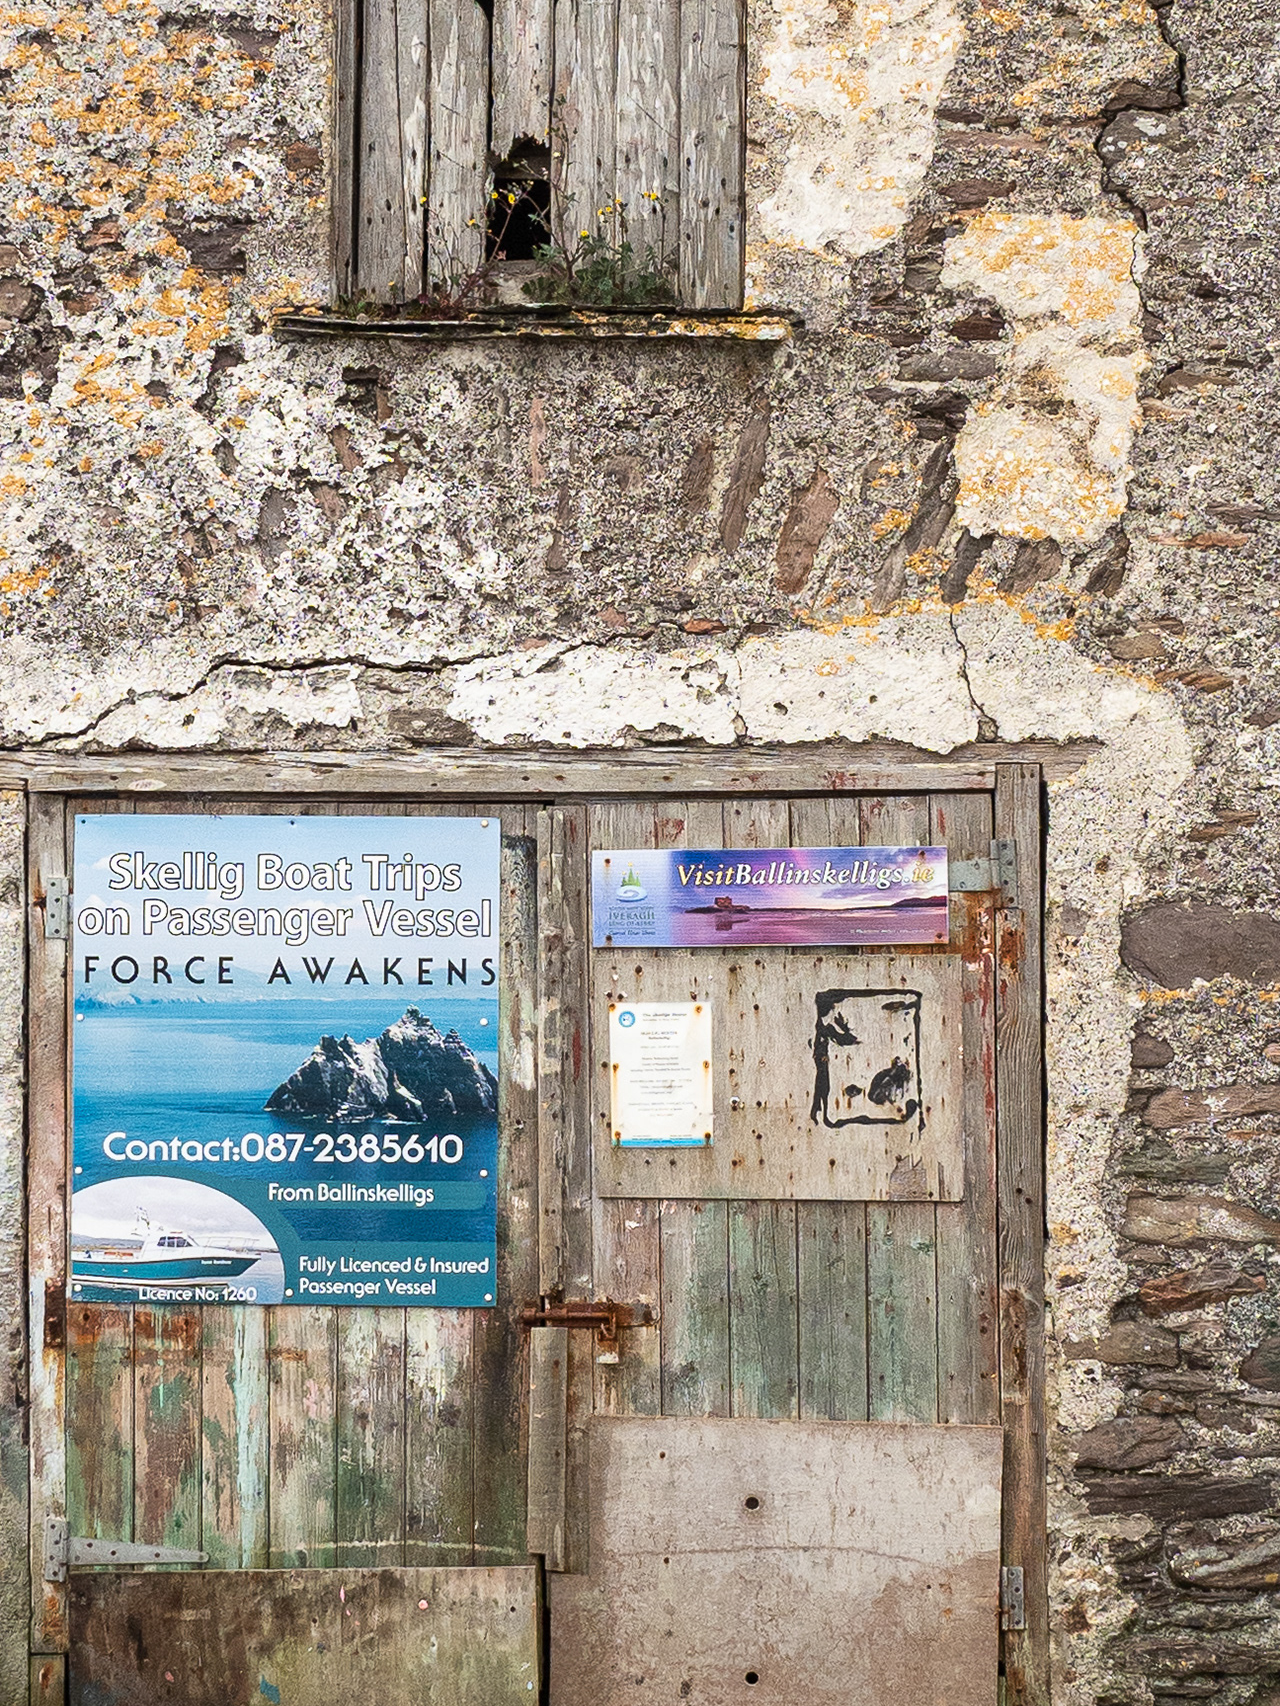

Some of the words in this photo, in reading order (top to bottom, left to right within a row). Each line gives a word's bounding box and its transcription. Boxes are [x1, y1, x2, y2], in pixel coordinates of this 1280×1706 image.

[108, 852, 245, 900] Skellig
[257, 854, 352, 891] Boat
[362, 853, 461, 901] Trips
[676, 860, 935, 889] VisitBallinskelligs.ie
[78, 905, 130, 936] on
[142, 899, 353, 946] Passenger
[363, 899, 493, 938] Vessel
[84, 955, 234, 984] FORCE
[267, 956, 497, 986] AWAKENS
[268, 1183, 316, 1202] From
[317, 1183, 434, 1207] Ballinskelligs
[299, 1256, 336, 1276] Fully
[340, 1257, 412, 1273] Licenced
[414, 1257, 427, 1273] &
[430, 1257, 490, 1274] Insured
[139, 1286, 193, 1301] Licence
[195, 1286, 219, 1301] No:
[222, 1286, 257, 1301] 1260
[299, 1278, 381, 1299] Passenger
[384, 1278, 436, 1295] Vessel
